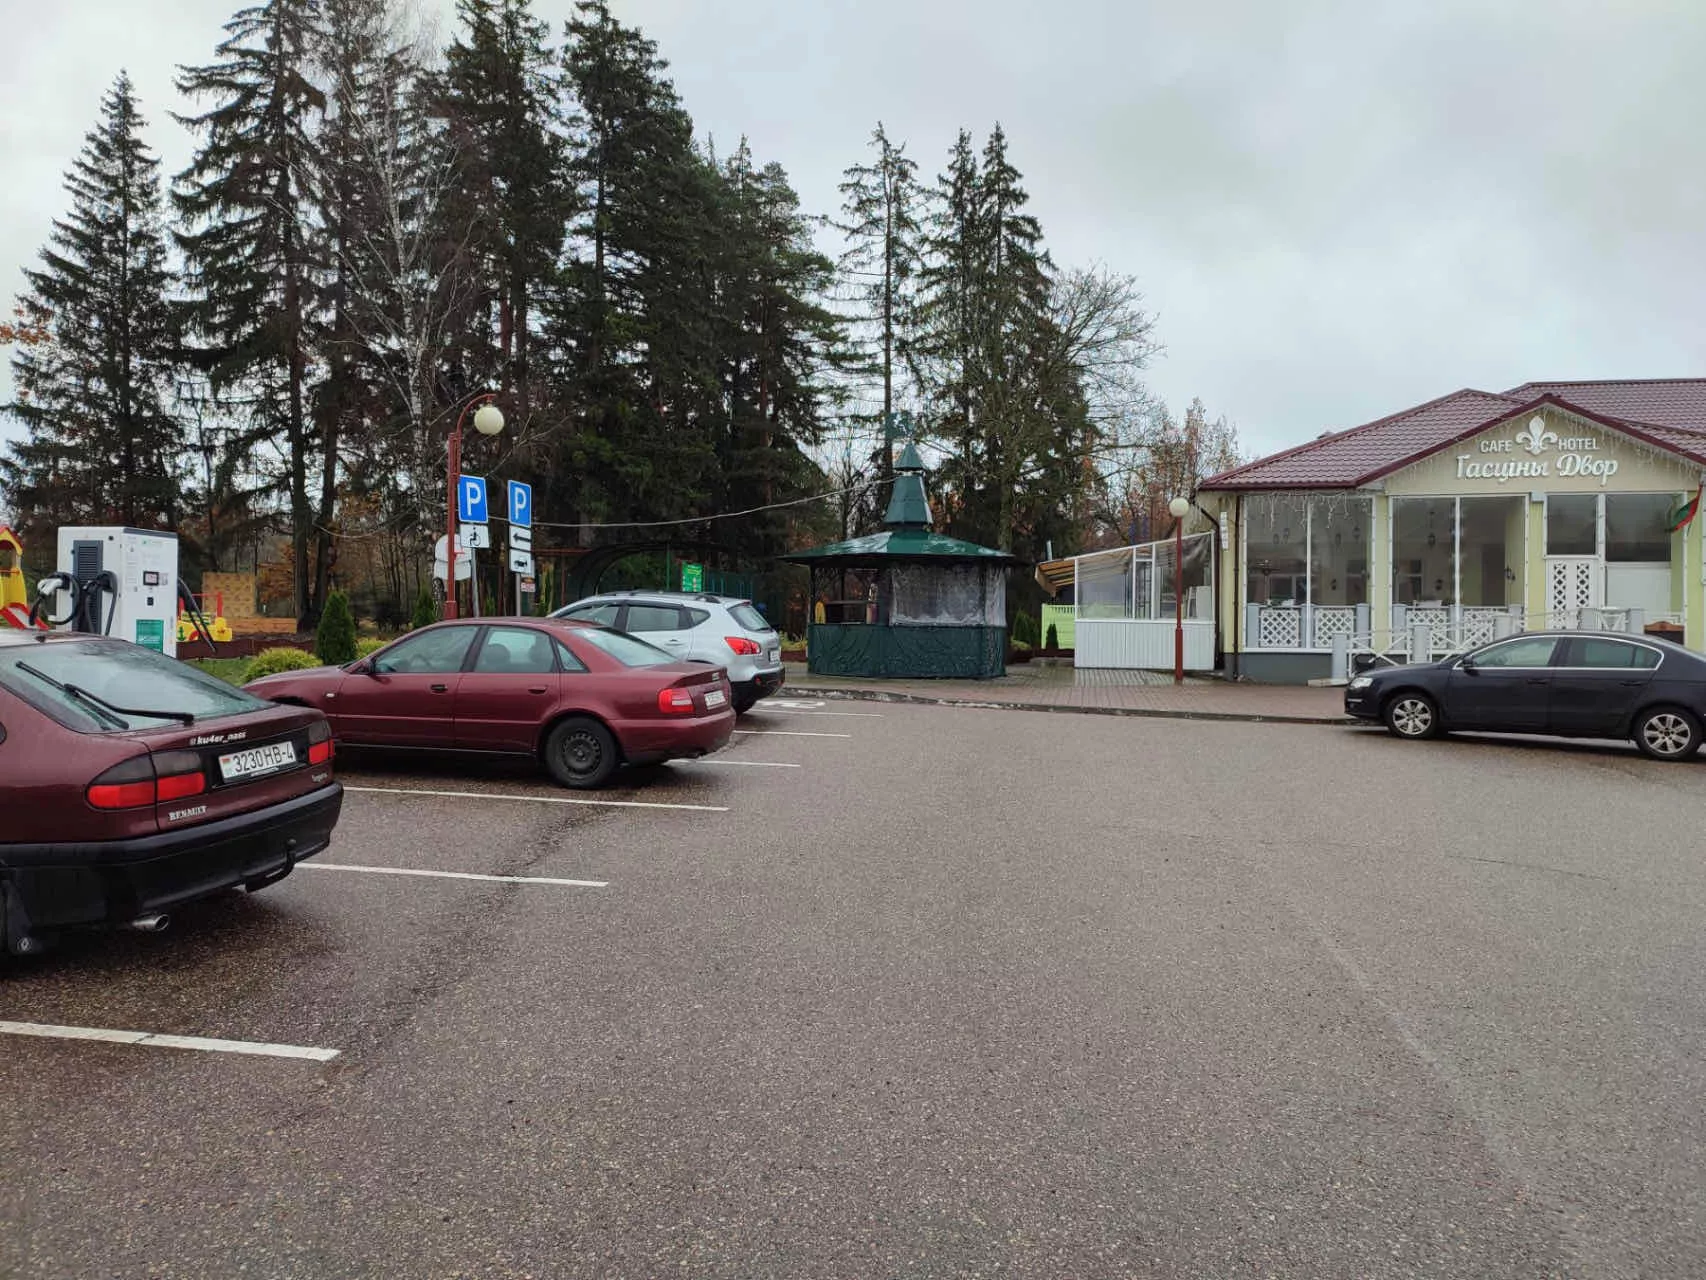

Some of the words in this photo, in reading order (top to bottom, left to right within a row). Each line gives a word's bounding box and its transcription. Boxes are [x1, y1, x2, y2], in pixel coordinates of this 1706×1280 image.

[1480, 439, 1514, 453] CAFE
[1558, 437, 1601, 451] HOTEL
[1556, 453, 1618, 487] Двор
[466, 481, 482, 516] P
[514, 487, 527, 520] P
[168, 805, 208, 821] RENAULT
